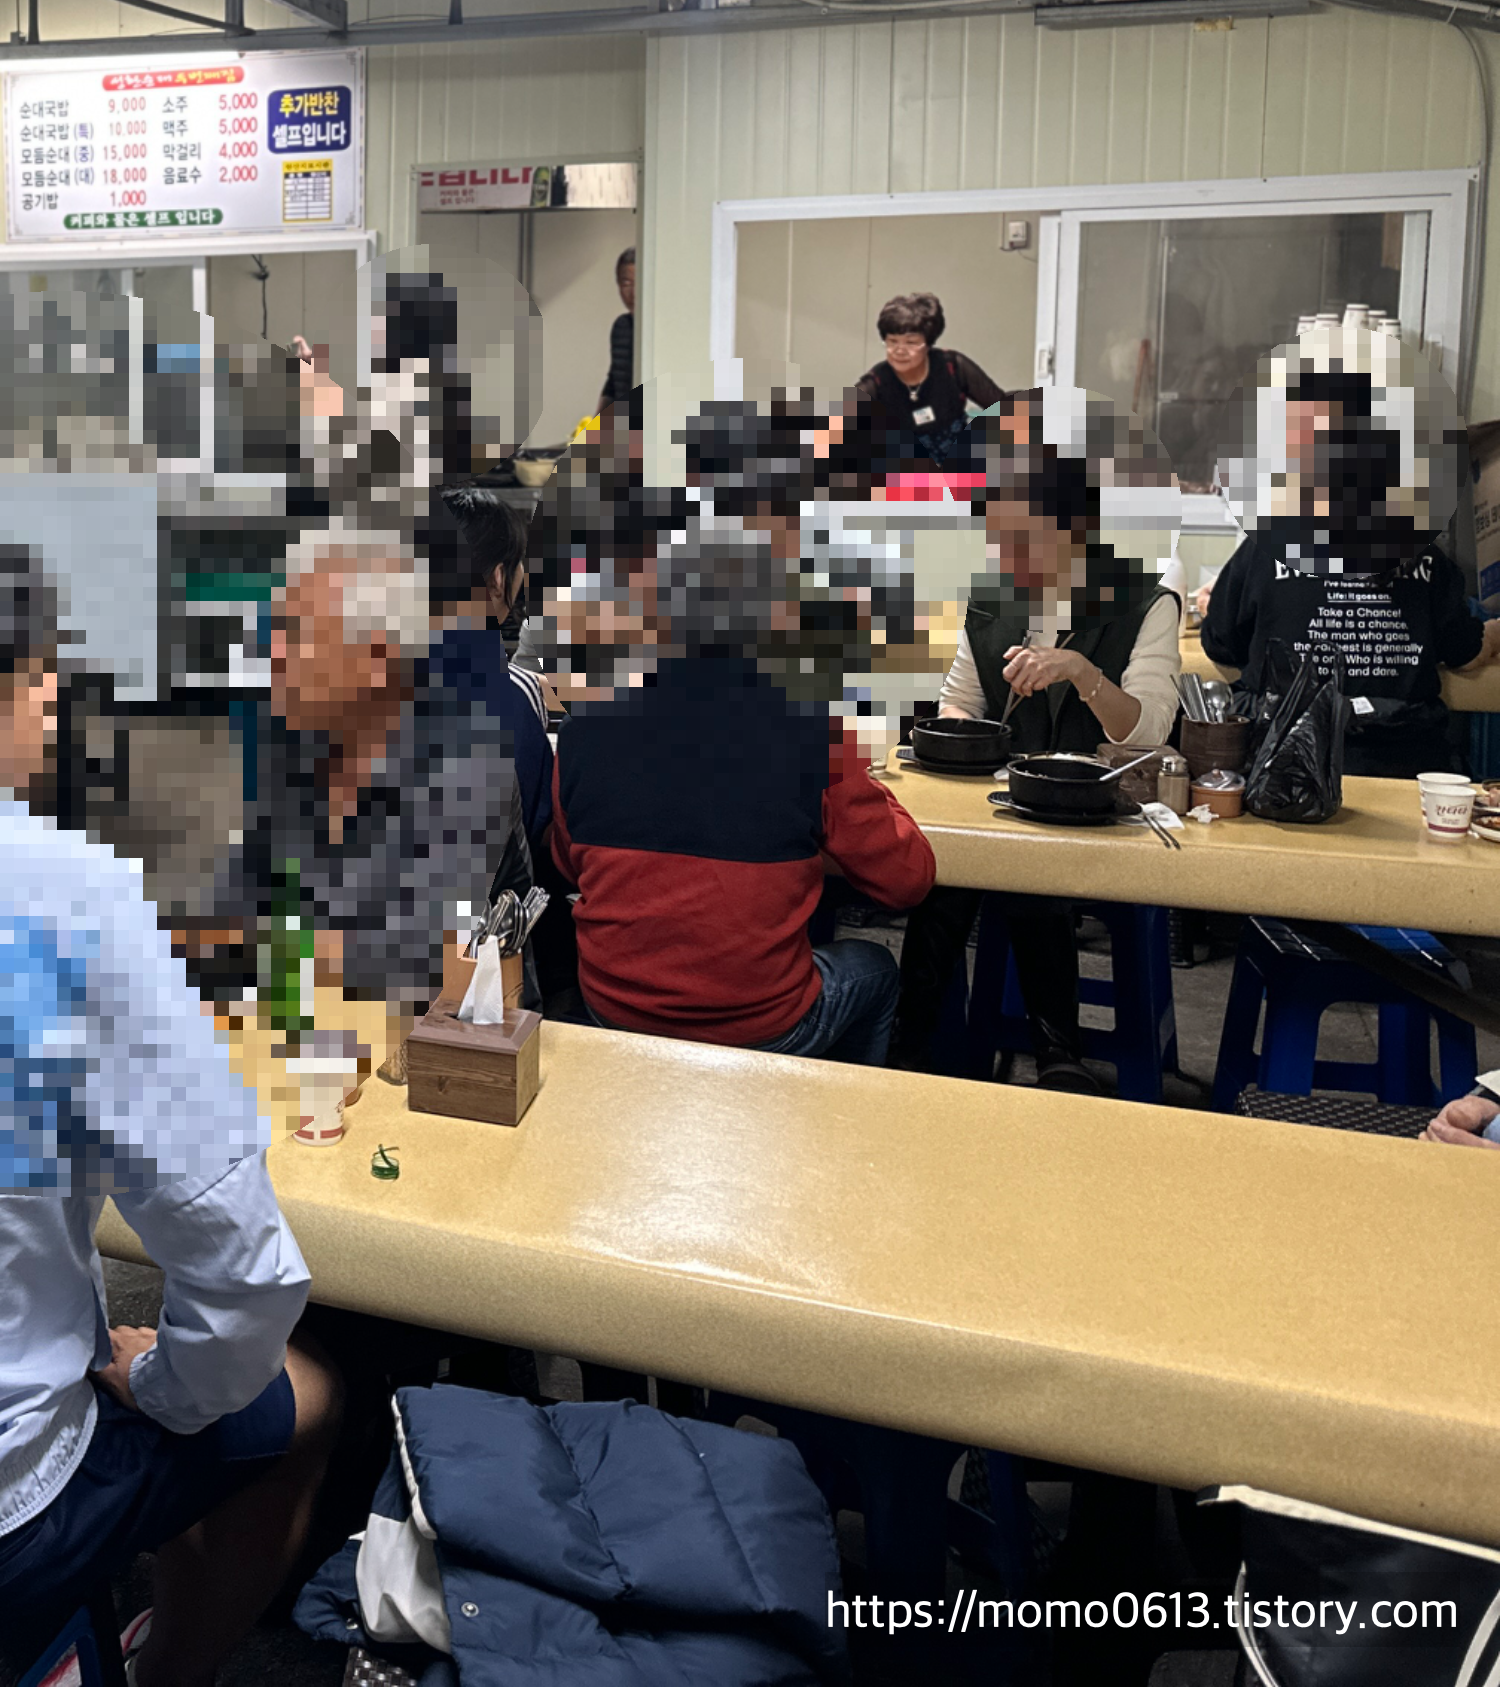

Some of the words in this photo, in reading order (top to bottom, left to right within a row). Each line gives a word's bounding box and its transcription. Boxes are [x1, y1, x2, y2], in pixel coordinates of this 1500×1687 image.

[19, 99, 69, 119] 순대국밥
[108, 96, 146, 114] 9,000
[162, 96, 188, 113] 소주
[219, 92, 258, 111] 5,000
[279, 91, 340, 118] 추가반찬
[20, 122, 69, 142] 순대국밥
[162, 120, 188, 138] 맥주
[219, 116, 258, 136] 5,000
[272, 120, 347, 149] 셀프입니다
[103, 143, 146, 162] 15,000
[162, 142, 202, 161] 막걸리
[218, 140, 258, 160] 4,000
[73, 167, 94, 186] (대)
[103, 167, 146, 185] 18,000
[162, 165, 202, 185] 음료수
[219, 164, 258, 184] 2,000
[22, 192, 59, 211] 공기밥
[110, 189, 146, 208] 1,000
[70, 213, 109, 229] 커피와
[145, 210, 171, 227] 셀프
[175, 208, 215, 225] 입니다
[1318, 606, 1343, 618] Take
[1346, 609, 1354, 618] a
[1357, 607, 1401, 618] Chance!
[1309, 618, 1324, 628] All
[1326, 618, 1342, 629] life
[1345, 618, 1355, 629] is
[1358, 620, 1366, 629] a
[1368, 619, 1408, 630] chance.
[1307, 630, 1328, 640] The
[1331, 632, 1356, 640] man
[1359, 630, 1383, 640] who
[1385, 632, 1410, 642] goes
[1293, 641, 1312, 652] the
[1362, 642, 1372, 652] is
[1374, 643, 1424, 654] generally
[1299, 652, 1320, 664] Te
[1345, 654, 1371, 664] Who
[1373, 654, 1383, 664] is
[1385, 655, 1419, 666] willing
[1318, 666, 1330, 676] to
[1348, 666, 1370, 677] and
[1372, 666, 1400, 677] dare.
